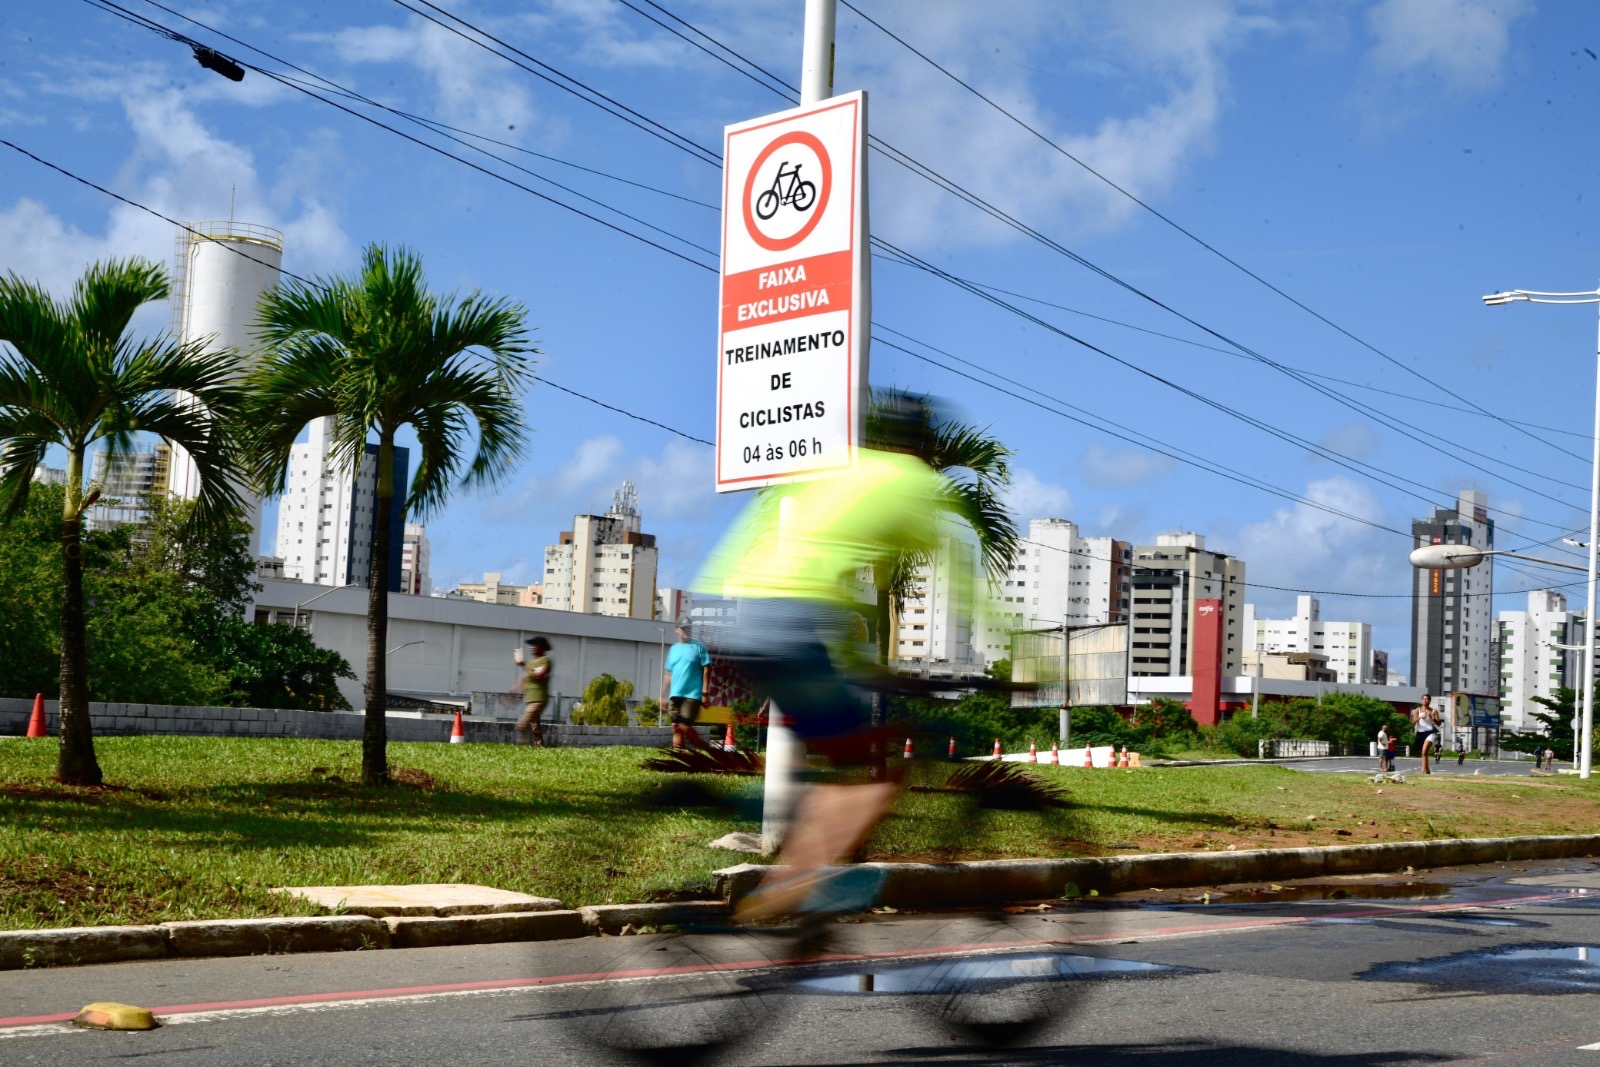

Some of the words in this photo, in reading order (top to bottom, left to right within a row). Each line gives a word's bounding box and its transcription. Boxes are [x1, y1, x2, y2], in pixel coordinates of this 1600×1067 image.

[758, 264, 807, 290] FAIXA
[737, 288, 830, 322] EXCLUSIVA
[725, 329, 845, 365] TREINAMENTO
[770, 371, 792, 391] DE
[739, 400, 825, 429] CICLISTAS
[743, 444, 761, 464] 04
[766, 442, 784, 461] às
[789, 438, 807, 458] 06
[812, 437, 822, 455] h
